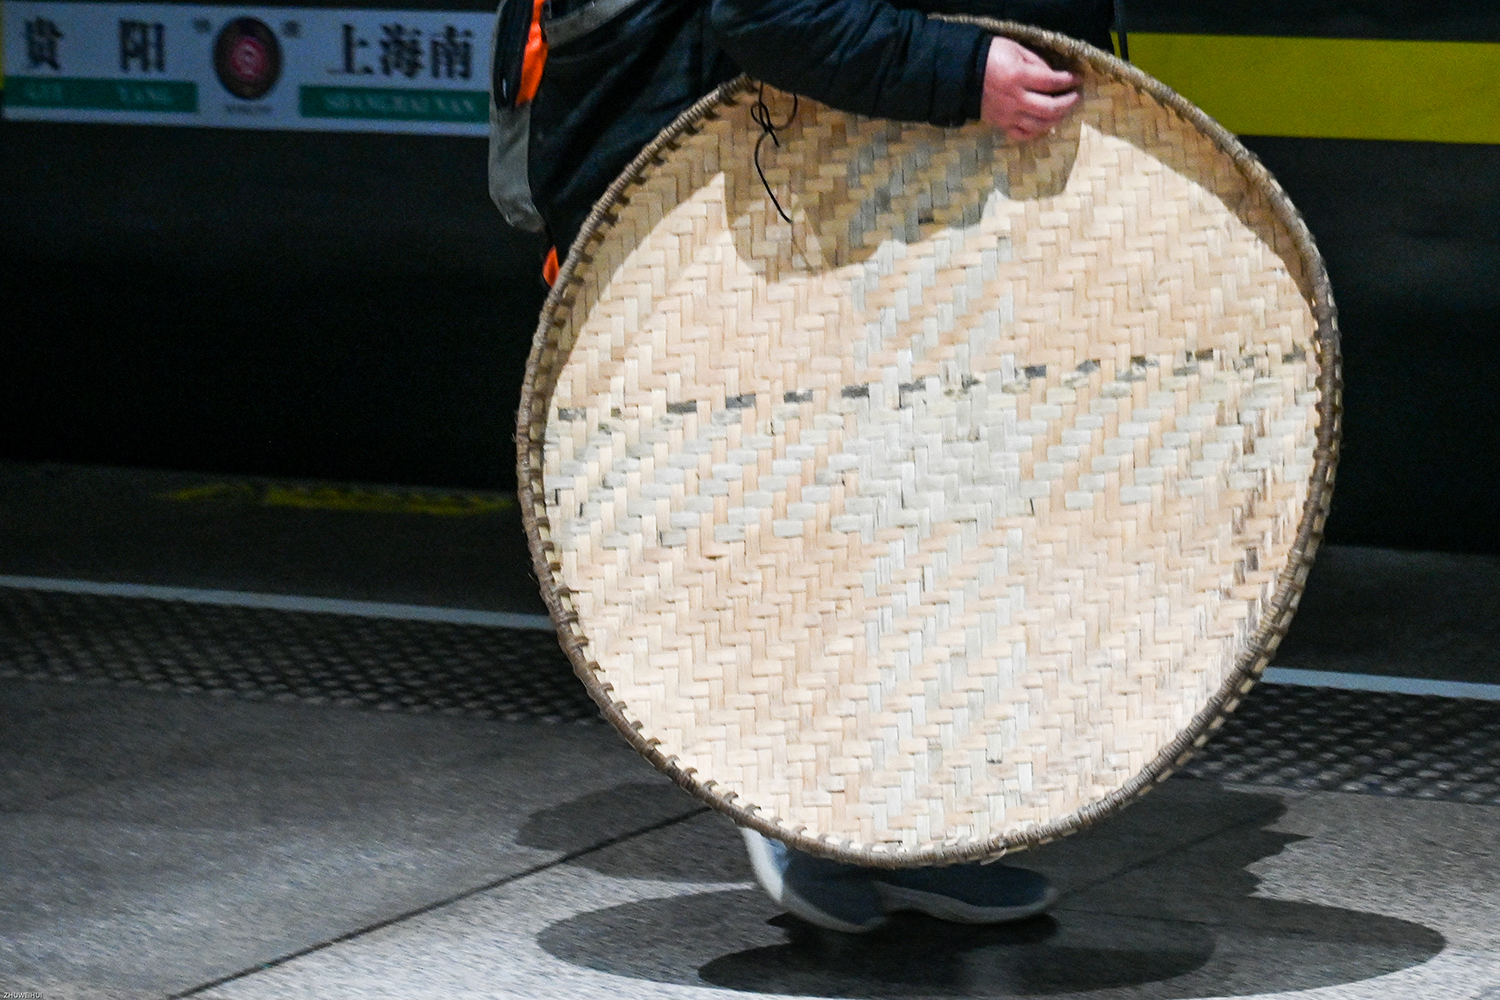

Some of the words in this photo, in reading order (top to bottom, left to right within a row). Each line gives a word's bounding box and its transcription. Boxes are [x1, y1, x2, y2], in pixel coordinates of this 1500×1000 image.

[22, 16, 167, 73] 贵阳
[327, 22, 476, 80] 上海南
